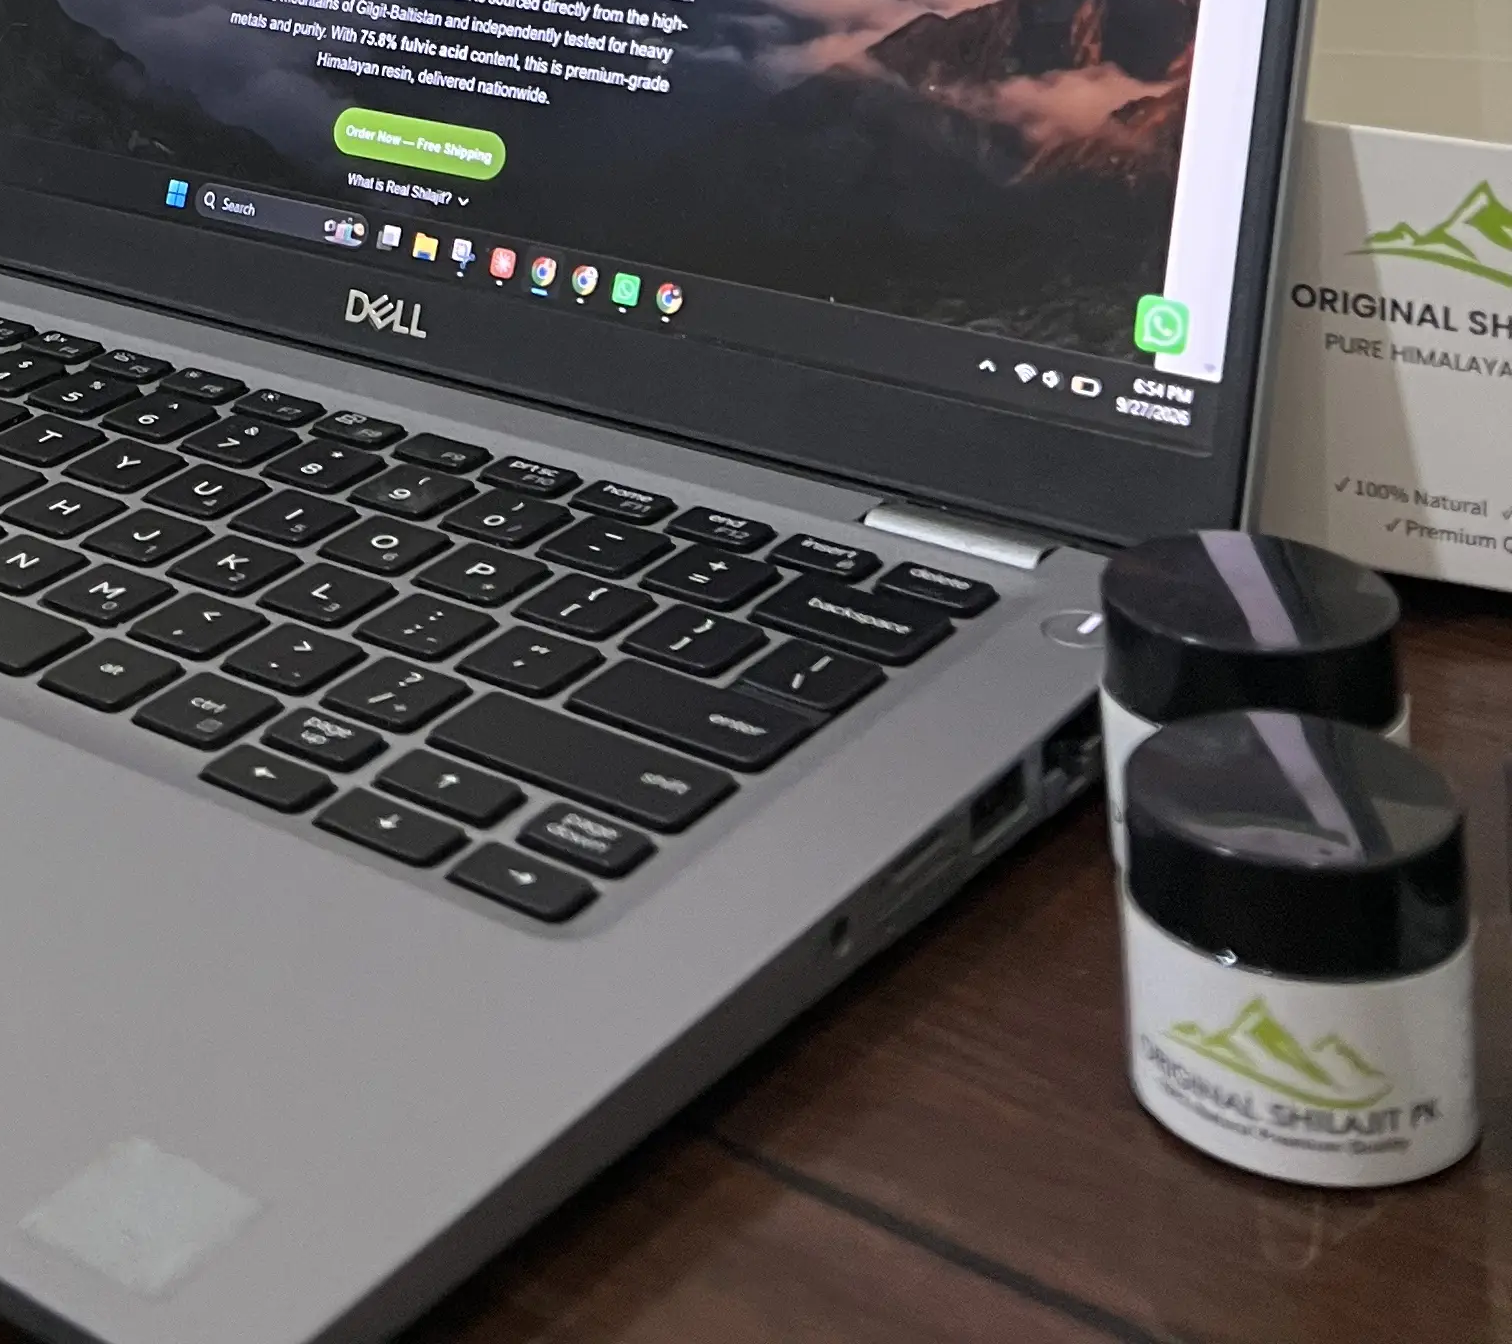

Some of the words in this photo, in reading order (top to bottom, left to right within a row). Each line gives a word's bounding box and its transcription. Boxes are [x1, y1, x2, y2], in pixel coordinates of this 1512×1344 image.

[355, 0, 443, 27] Gilgit-Baltistan
[443, 15, 470, 31] and
[470, 16, 562, 48] independently
[562, 30, 607, 51] tested
[606, 36, 628, 54] for
[628, 39, 674, 65] heavy
[591, 3, 625, 23] from
[625, 8, 650, 27] the
[650, 11, 689, 34] high-
[229, 12, 268, 29] metals
[268, 18, 292, 33] and
[291, 21, 328, 41] purity.
[330, 24, 359, 43] With
[358, 28, 399, 51] 75.8%
[399, 35, 438, 56] fulvic
[437, 43, 470, 61] acid
[469, 49, 522, 72] content,
[523, 55, 550, 74] this
[549, 59, 564, 76] is
[563, 64, 671, 93] premium-grade
[315, 51, 380, 77] Himalayan
[380, 64, 415, 84] resin,
[416, 68, 476, 92] delivered
[476, 80, 551, 105] nationwide.
[344, 124, 377, 141] Order
[376, 130, 402, 146] Now
[415, 136, 442, 154] Free
[442, 142, 493, 166] Shipping
[347, 172, 375, 190] What
[374, 180, 384, 192] is
[385, 179, 411, 197] Real
[220, 197, 256, 217] Search
[344, 288, 427, 340] DELL
[1290, 283, 1458, 332] ORIGINAL
[1323, 332, 1383, 360] PURE
[38, 429, 63, 443] T
[116, 455, 141, 469] Y
[1354, 479, 1409, 504] 100%
[1412, 489, 1488, 517] Natural
[1404, 519, 1496, 549] Premium
